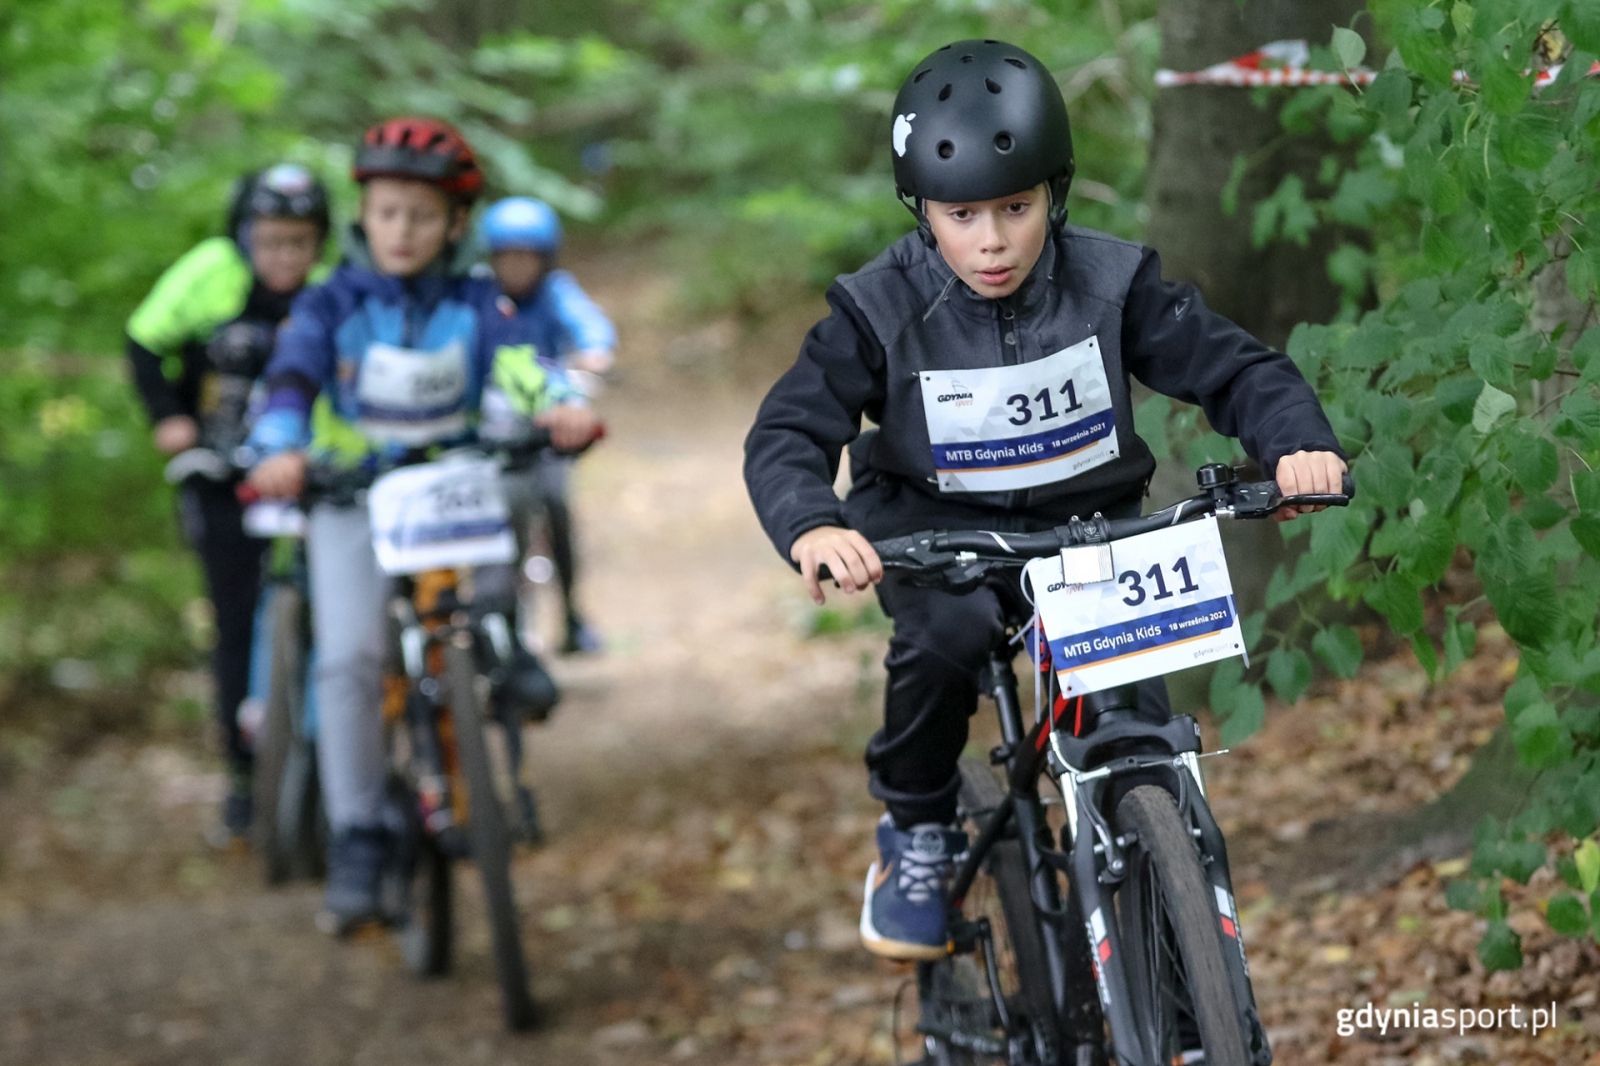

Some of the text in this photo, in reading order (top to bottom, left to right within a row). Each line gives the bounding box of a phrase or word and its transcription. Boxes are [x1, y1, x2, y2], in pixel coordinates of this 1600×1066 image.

[937, 393, 973, 402] GDYNIA
[1006, 378, 1083, 426] 311
[945, 422, 1106, 462] MTB Gdynia Kids 18 września 2021
[1118, 556, 1199, 607] 311
[1063, 610, 1227, 659] MTB Gdynia Kids 18 września 2021
